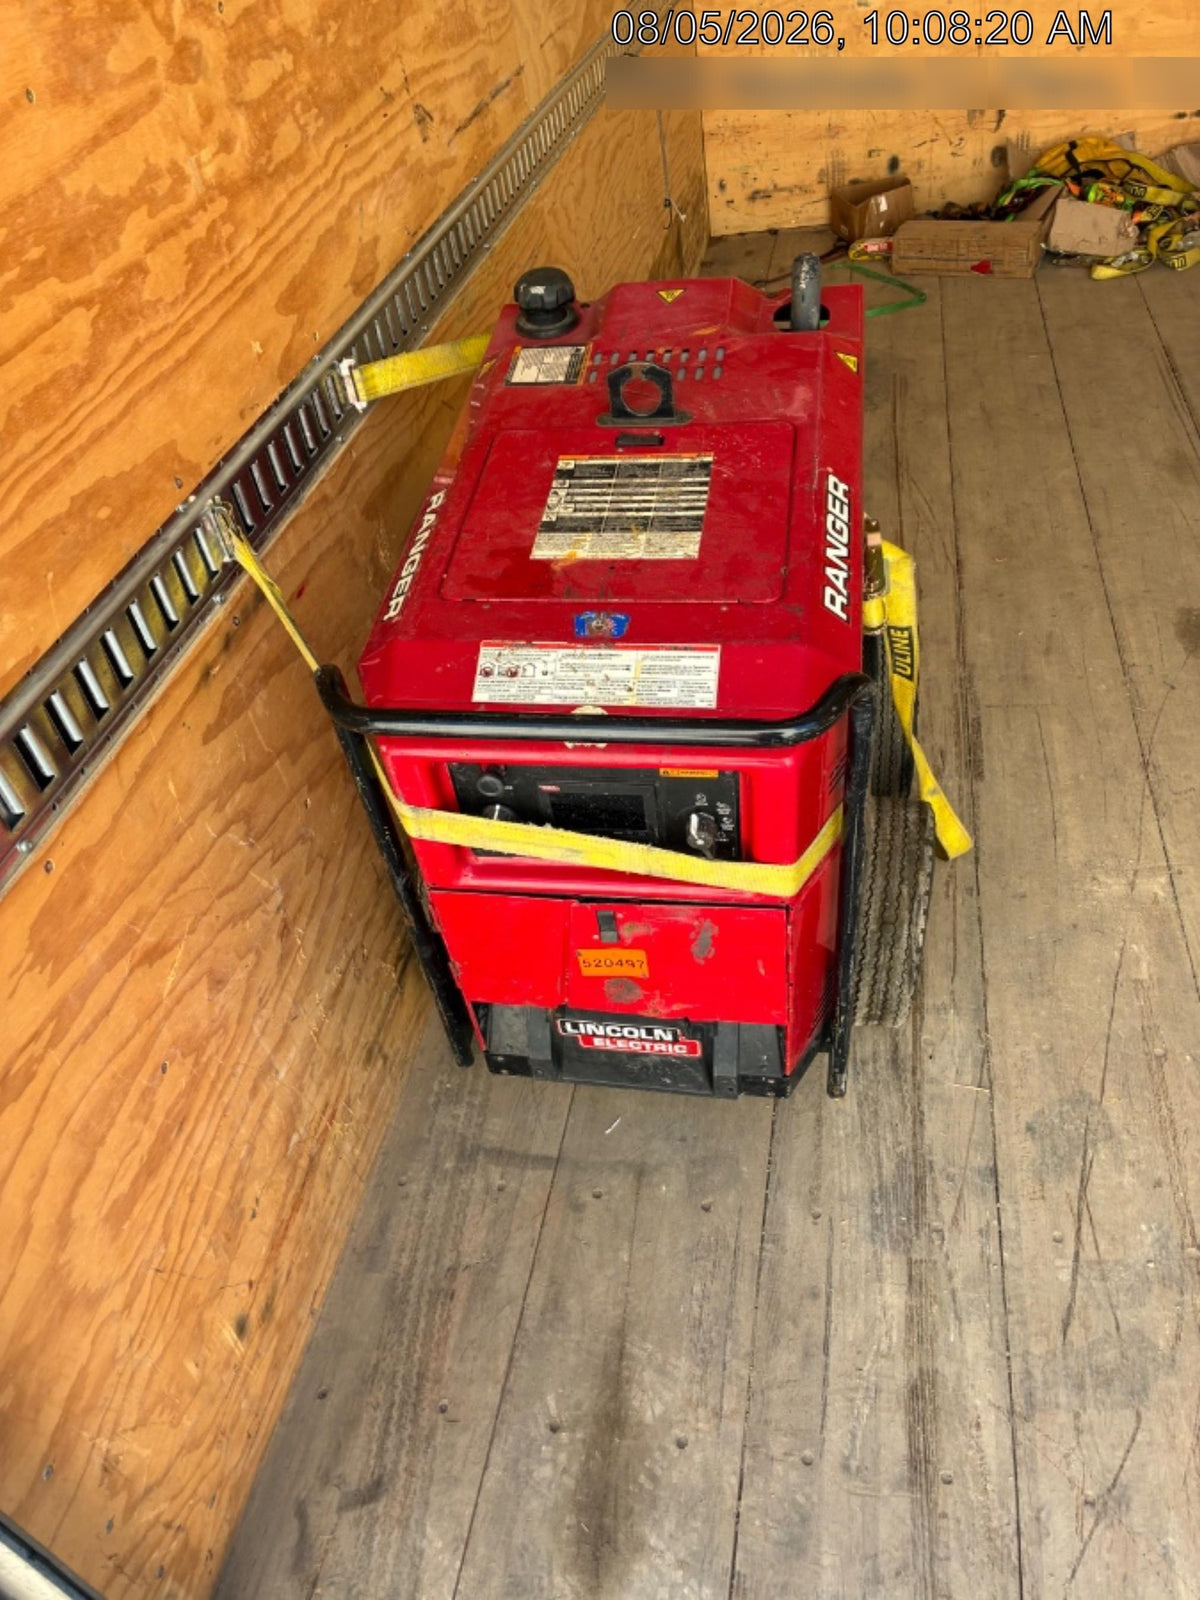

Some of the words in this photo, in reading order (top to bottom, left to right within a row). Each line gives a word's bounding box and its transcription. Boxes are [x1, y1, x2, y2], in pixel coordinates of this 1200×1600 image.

[383, 489, 447, 621] RANGER
[824, 474, 851, 622] RANGER
[890, 627, 914, 679] ULINE
[581, 959, 645, 969] 520497
[564, 1021, 674, 1042] LINCOLN
[592, 1037, 688, 1054] ELECTRIC
